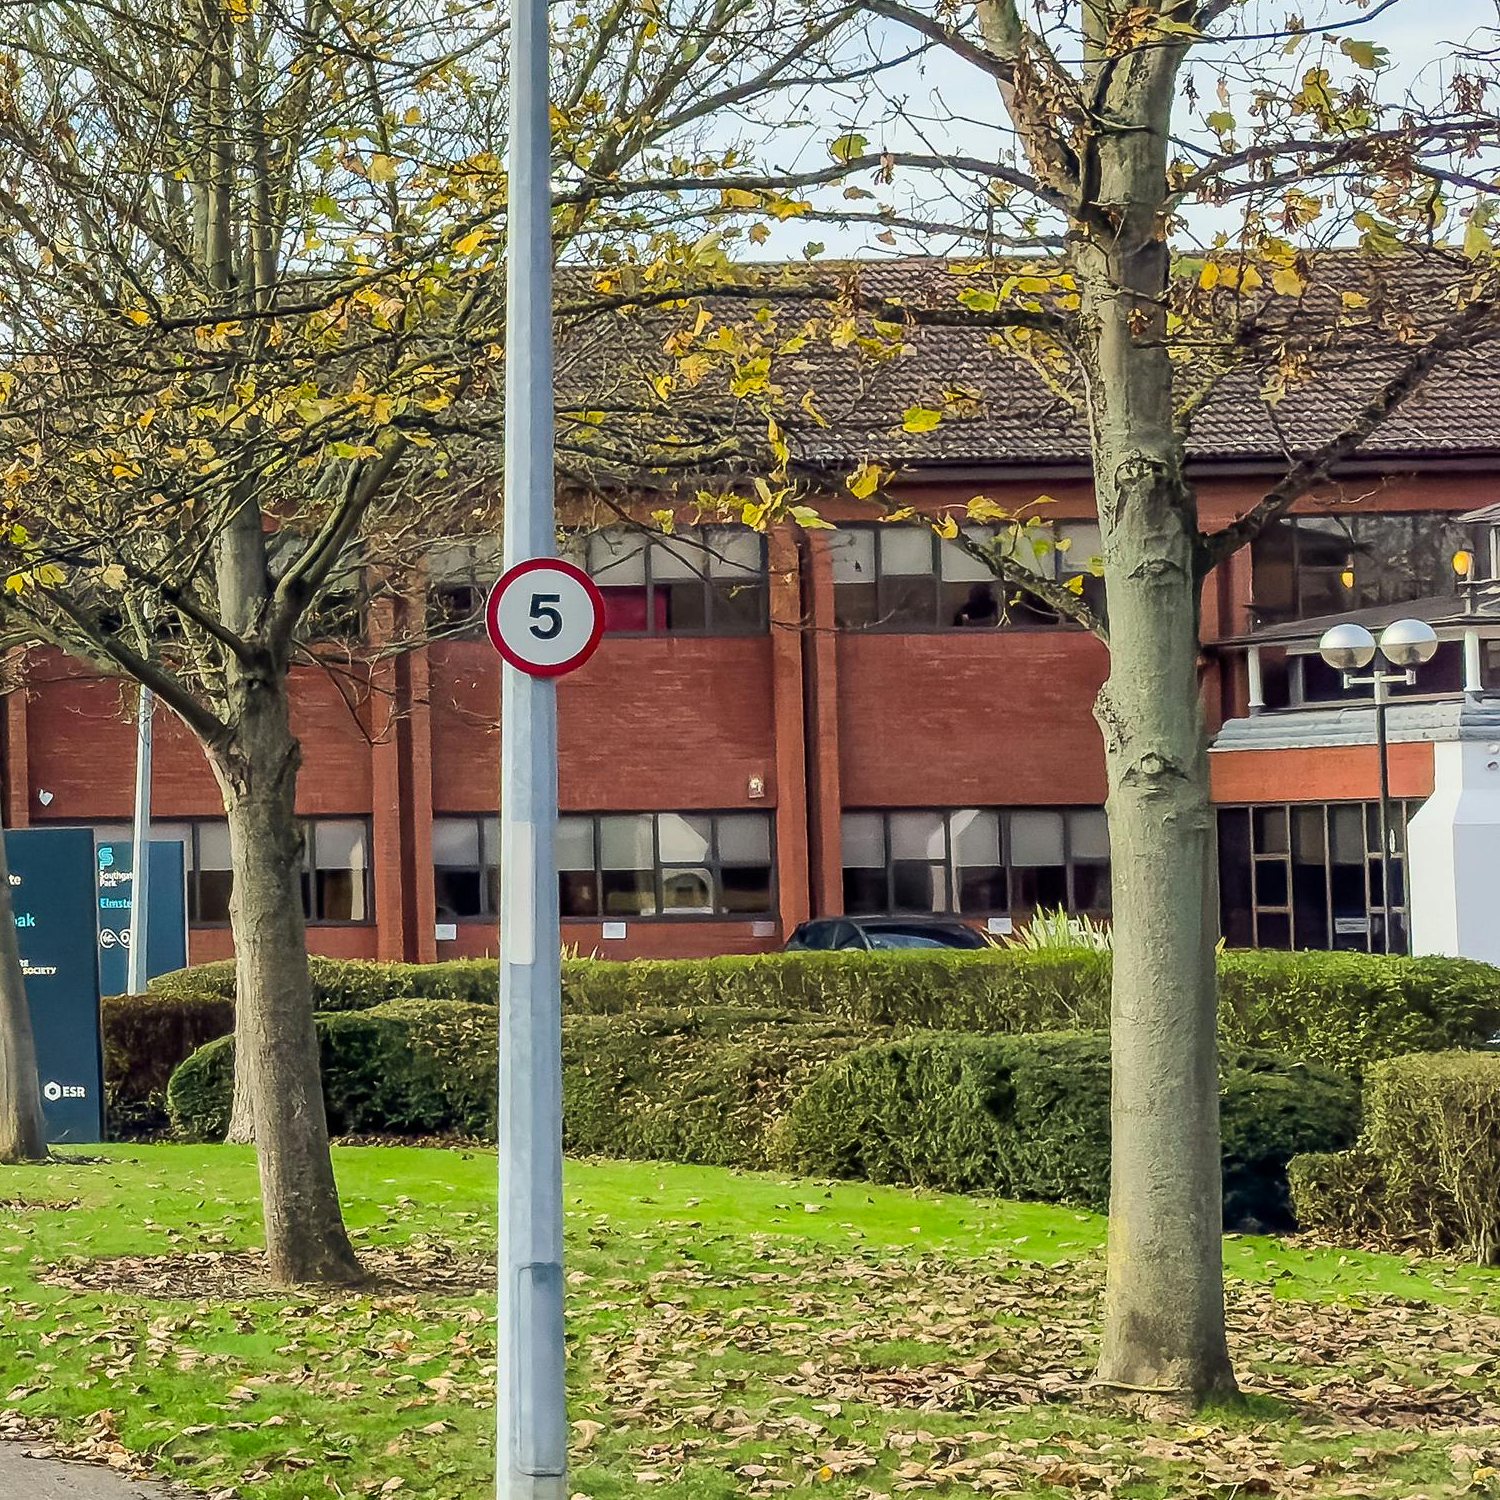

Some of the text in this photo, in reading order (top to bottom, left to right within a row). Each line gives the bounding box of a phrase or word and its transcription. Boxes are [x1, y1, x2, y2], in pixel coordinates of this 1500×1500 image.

[529, 593, 563, 640] 5
[99, 871, 133, 882] Southgat
[100, 879, 117, 887] Park
[100, 898, 132, 909] Elmste
[62, 1086, 86, 1097] ESR
